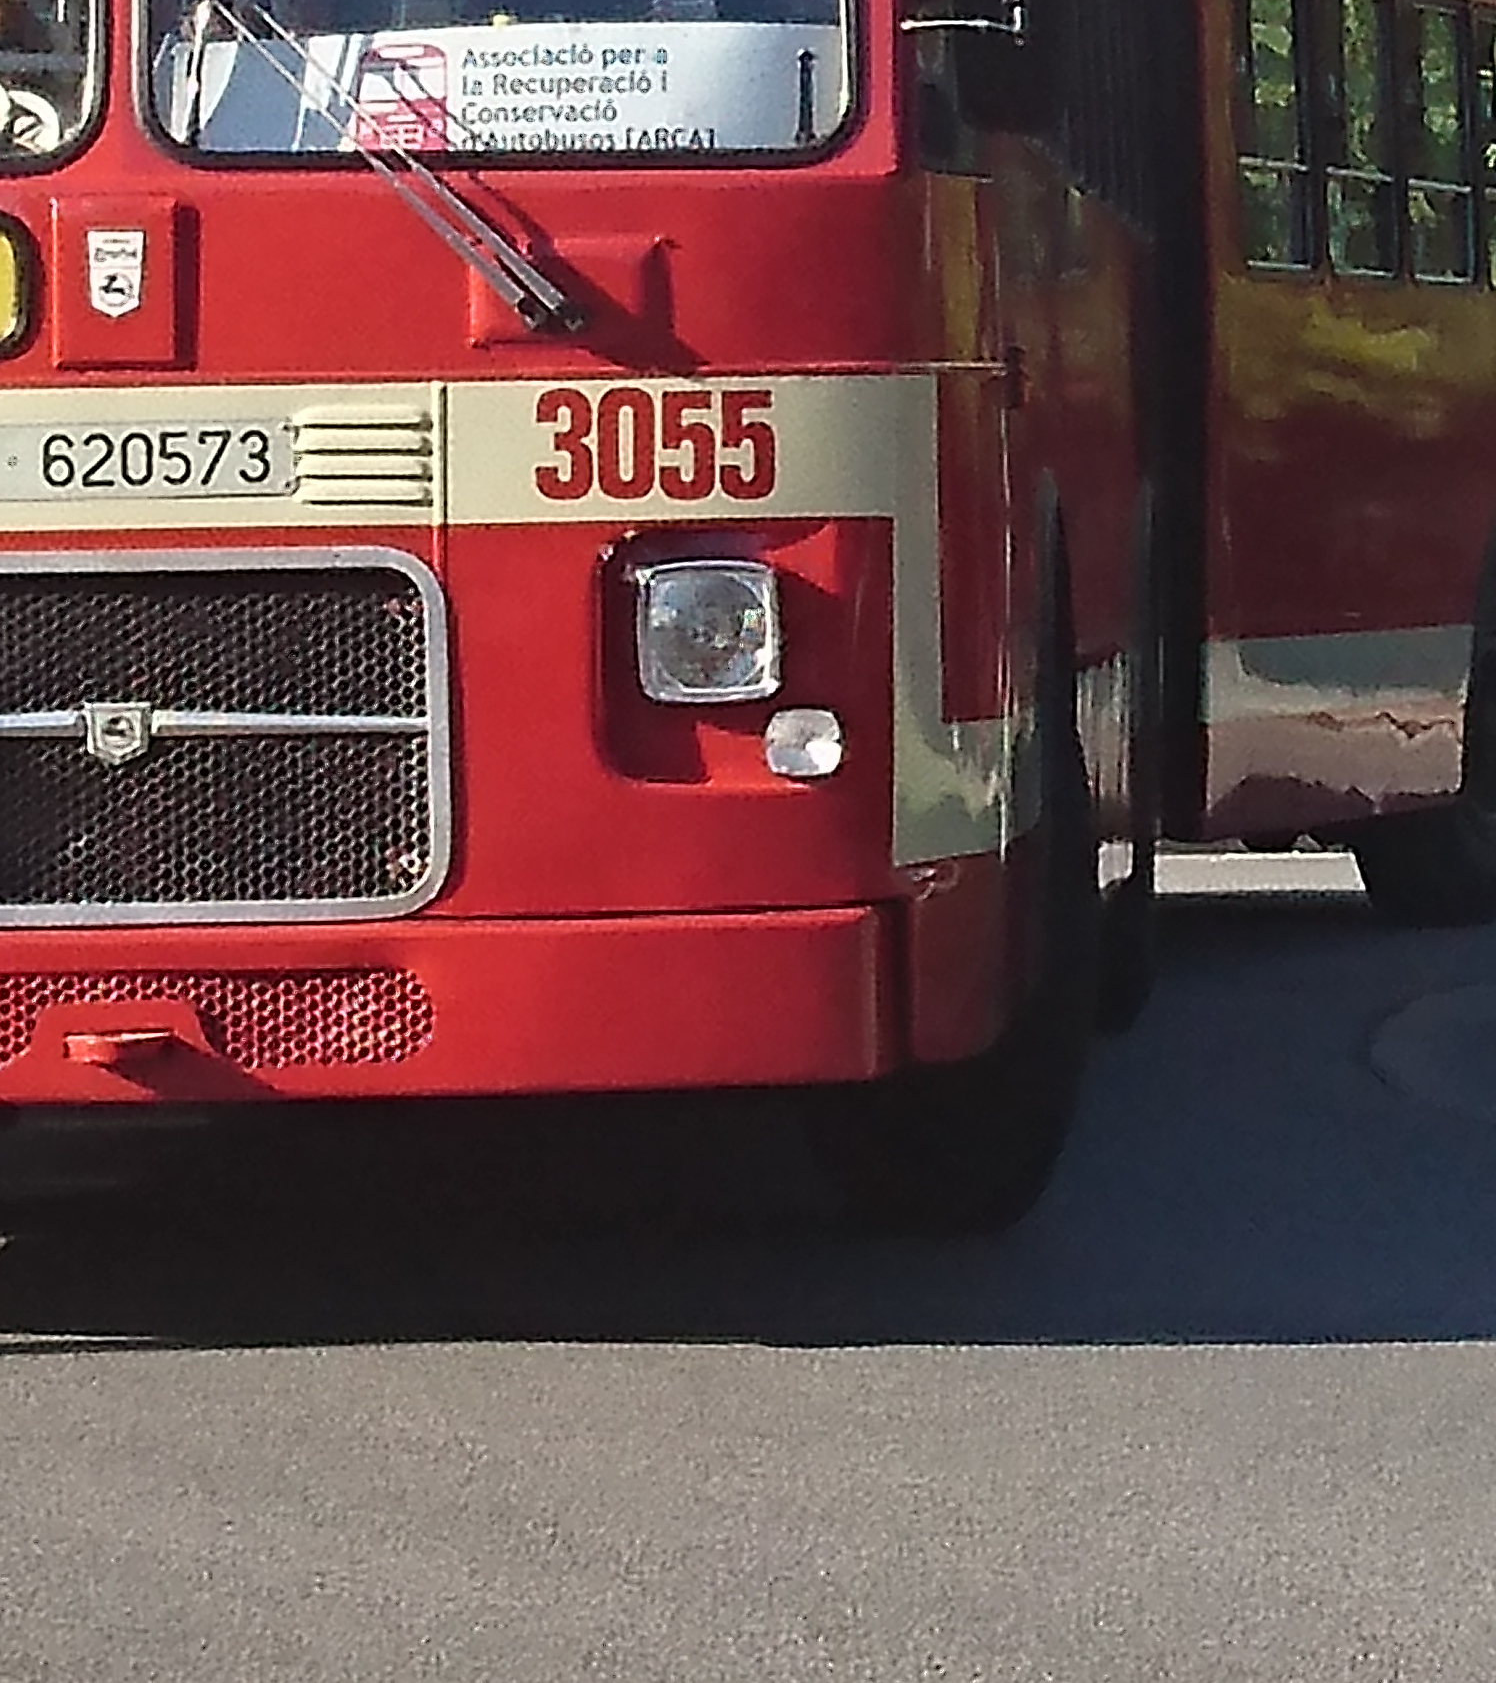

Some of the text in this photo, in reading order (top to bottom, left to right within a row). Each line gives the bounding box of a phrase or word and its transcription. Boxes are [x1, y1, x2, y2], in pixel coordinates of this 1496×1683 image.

[461, 43, 594, 69] Associació
[601, 47, 646, 70] per
[461, 74, 483, 96] la
[492, 70, 652, 100] Recuperació
[461, 98, 619, 125] Conservació
[42, 429, 271, 487] 620573
[534, 386, 776, 501] 3055
